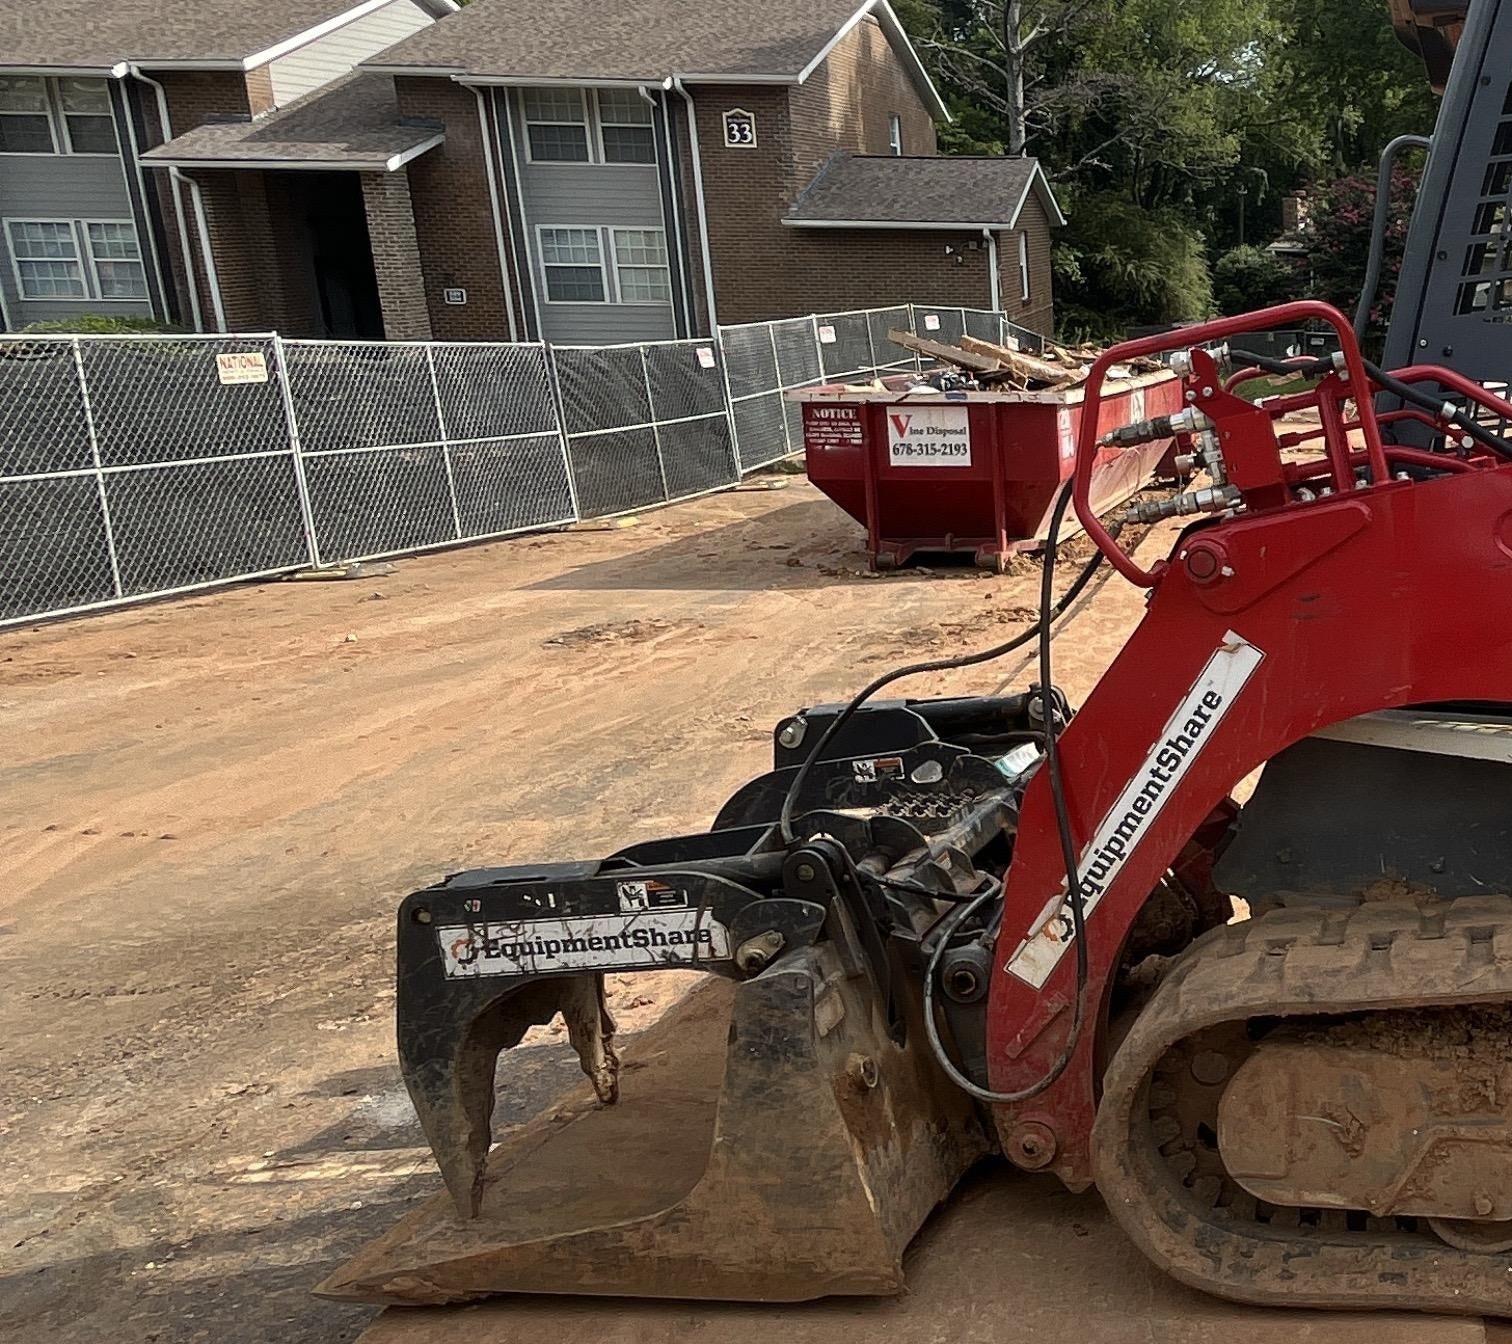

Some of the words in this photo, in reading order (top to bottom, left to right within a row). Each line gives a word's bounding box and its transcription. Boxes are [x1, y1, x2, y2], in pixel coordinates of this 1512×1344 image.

[728, 123, 752, 143] 33
[812, 408, 857, 419] NOTICE
[926, 426, 967, 438] Disposal
[893, 443, 968, 456] 678-315-2193
[484, 928, 712, 960] EquipmentShare
